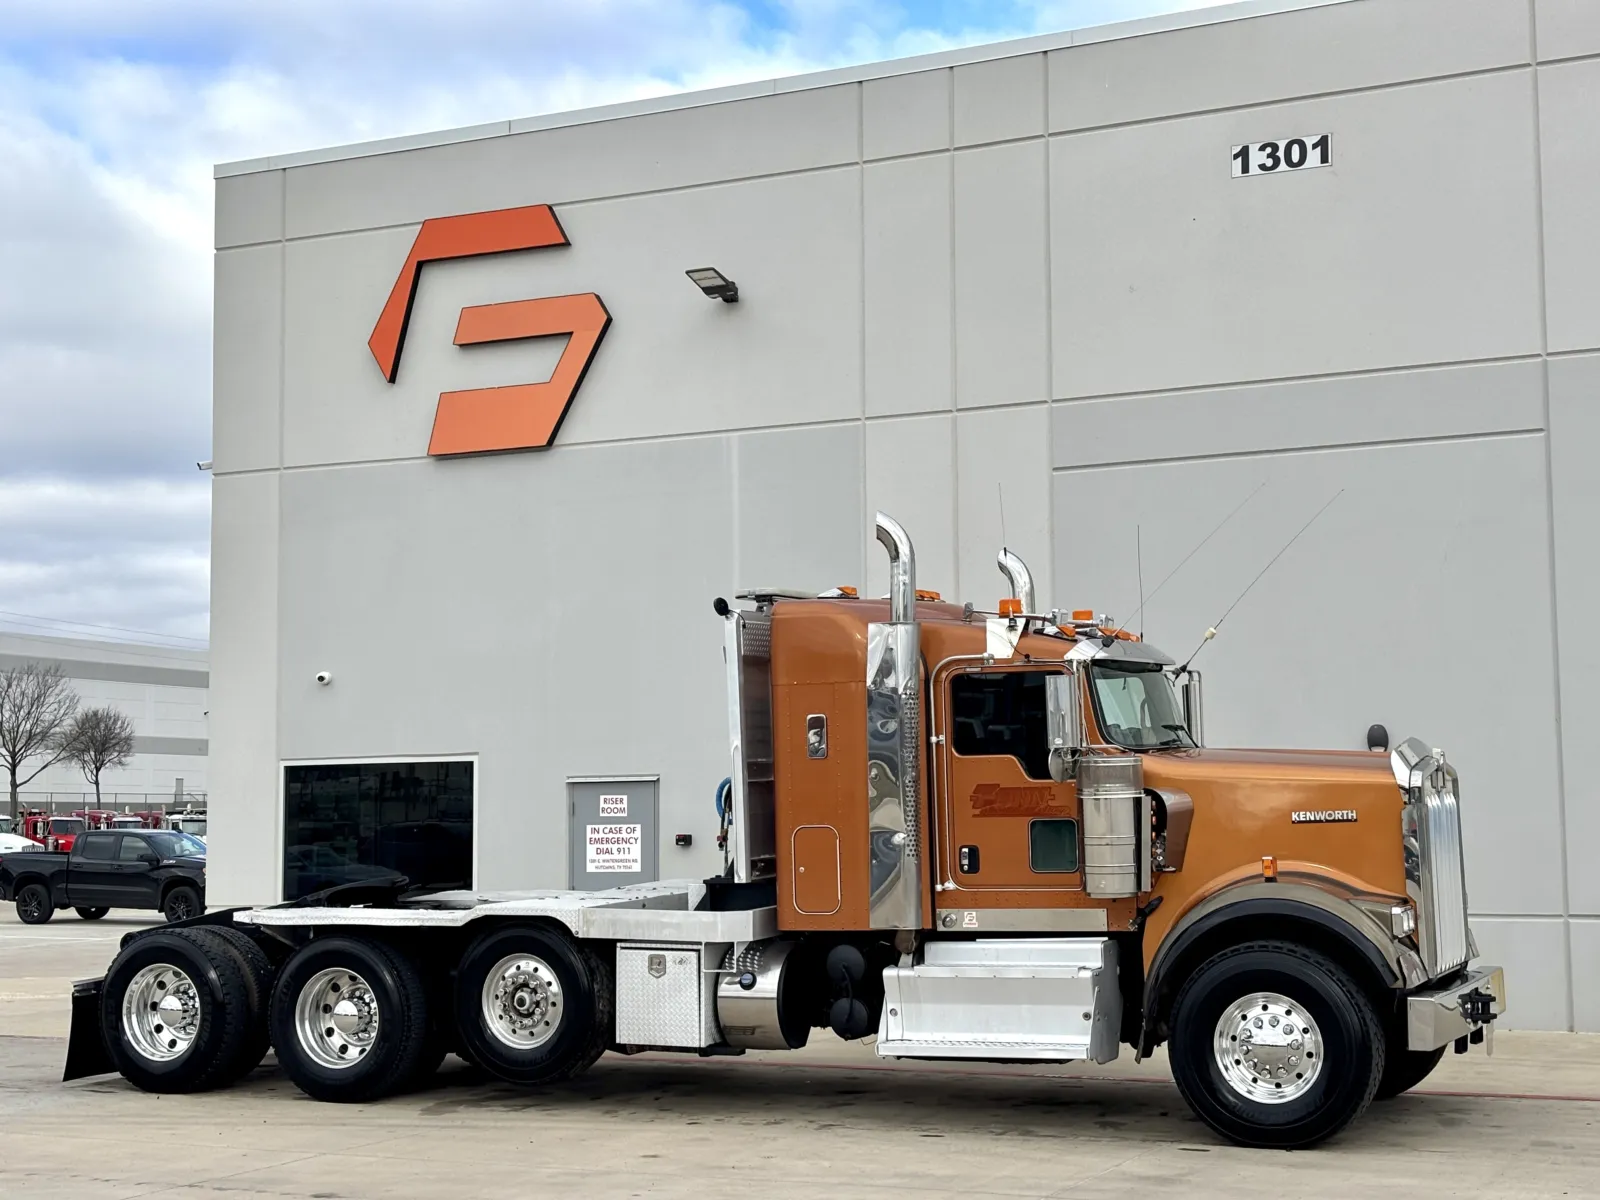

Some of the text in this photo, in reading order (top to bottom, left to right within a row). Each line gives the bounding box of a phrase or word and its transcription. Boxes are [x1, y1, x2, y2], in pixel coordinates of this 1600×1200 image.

[1232, 134, 1329, 175] 1301
[603, 797, 624, 805] RISER
[601, 807, 626, 815] ROOM
[1291, 809, 1357, 821] KENWORTH
[590, 826, 637, 835] IN CASE OF
[589, 836, 639, 845] EMERGENCY
[596, 847, 631, 855] DIAL 911
